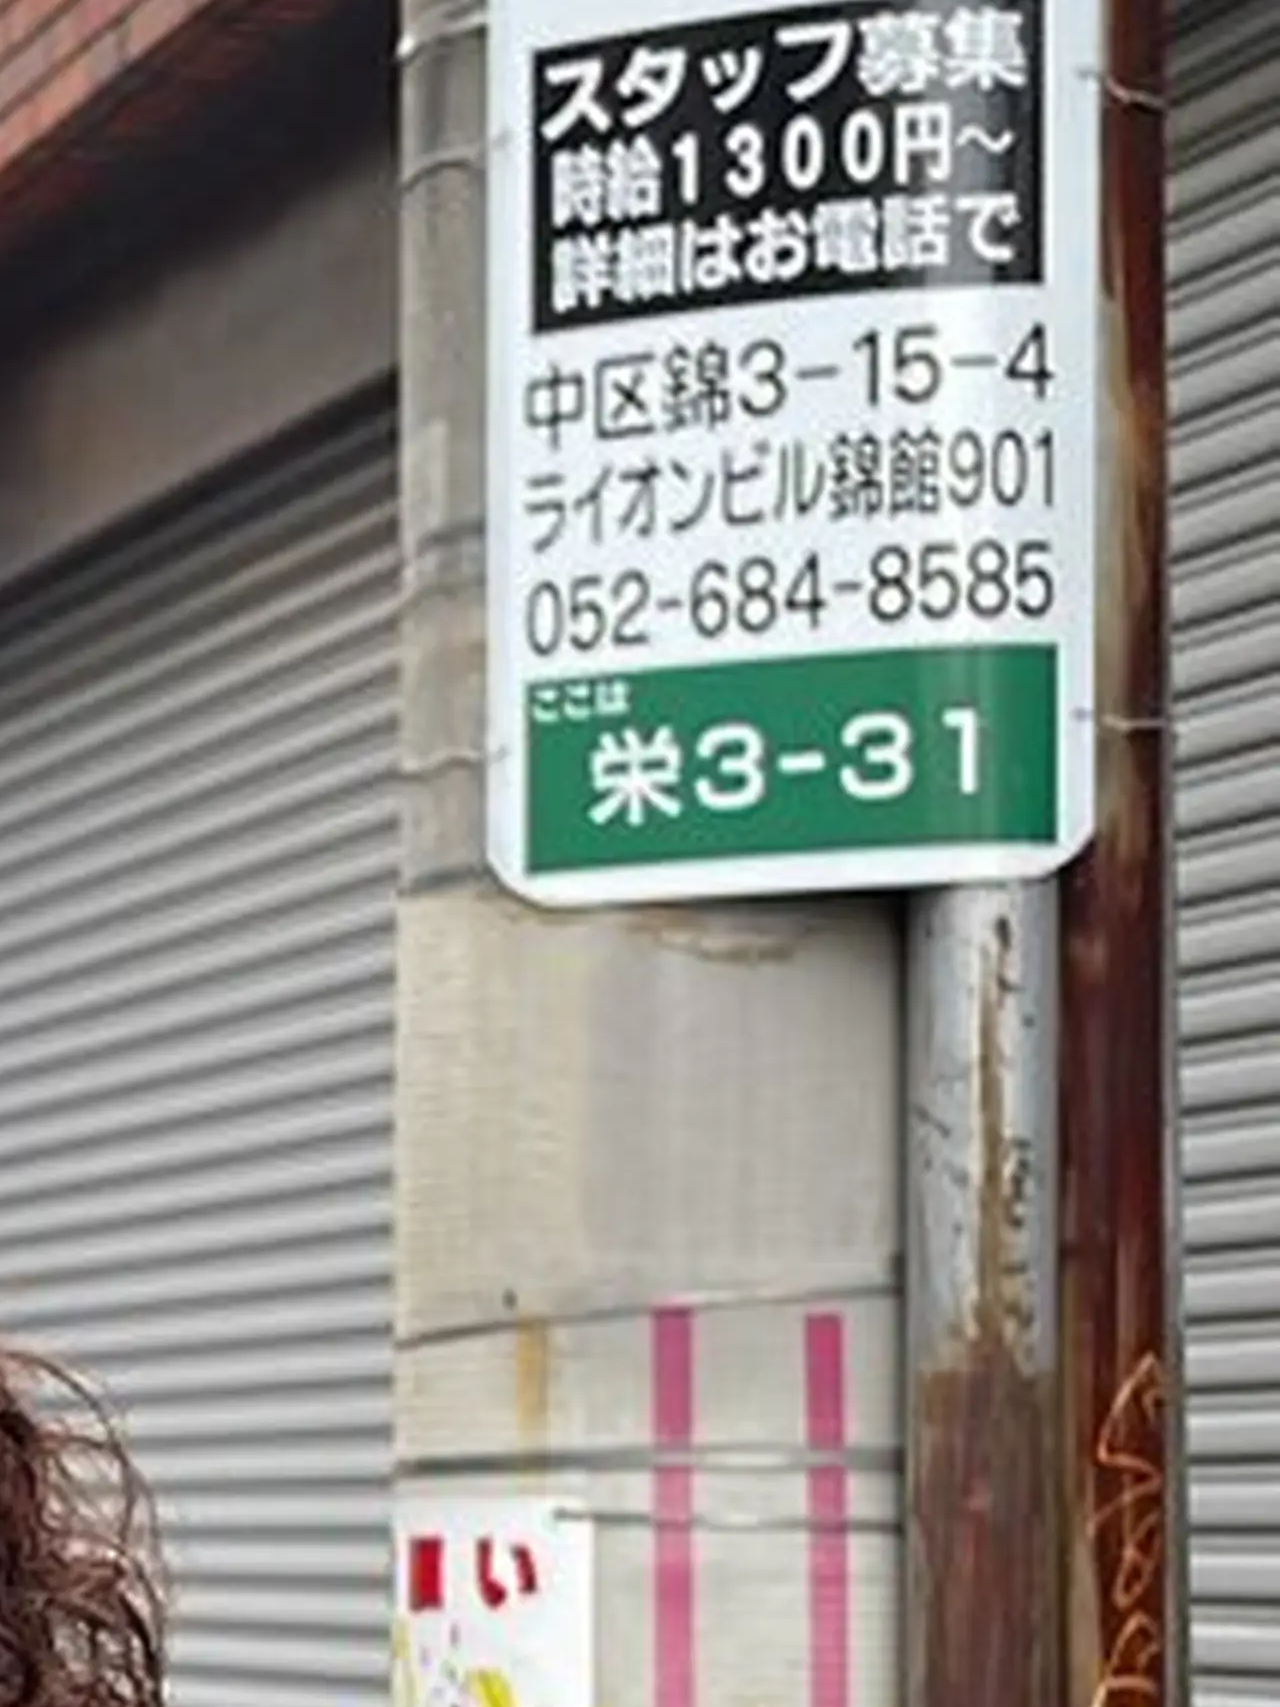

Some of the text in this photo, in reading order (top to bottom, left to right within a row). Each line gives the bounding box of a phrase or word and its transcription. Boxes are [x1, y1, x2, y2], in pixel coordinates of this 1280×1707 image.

[540, 5, 1026, 141] スタッフ募集
[550, 193, 1022, 314] 詳細はお電話で
[524, 323, 1056, 450] 中区錦3-15-4
[526, 538, 1055, 657] 052-684-8585
[532, 679, 630, 724] ここは
[588, 707, 984, 827] 栄3-31
